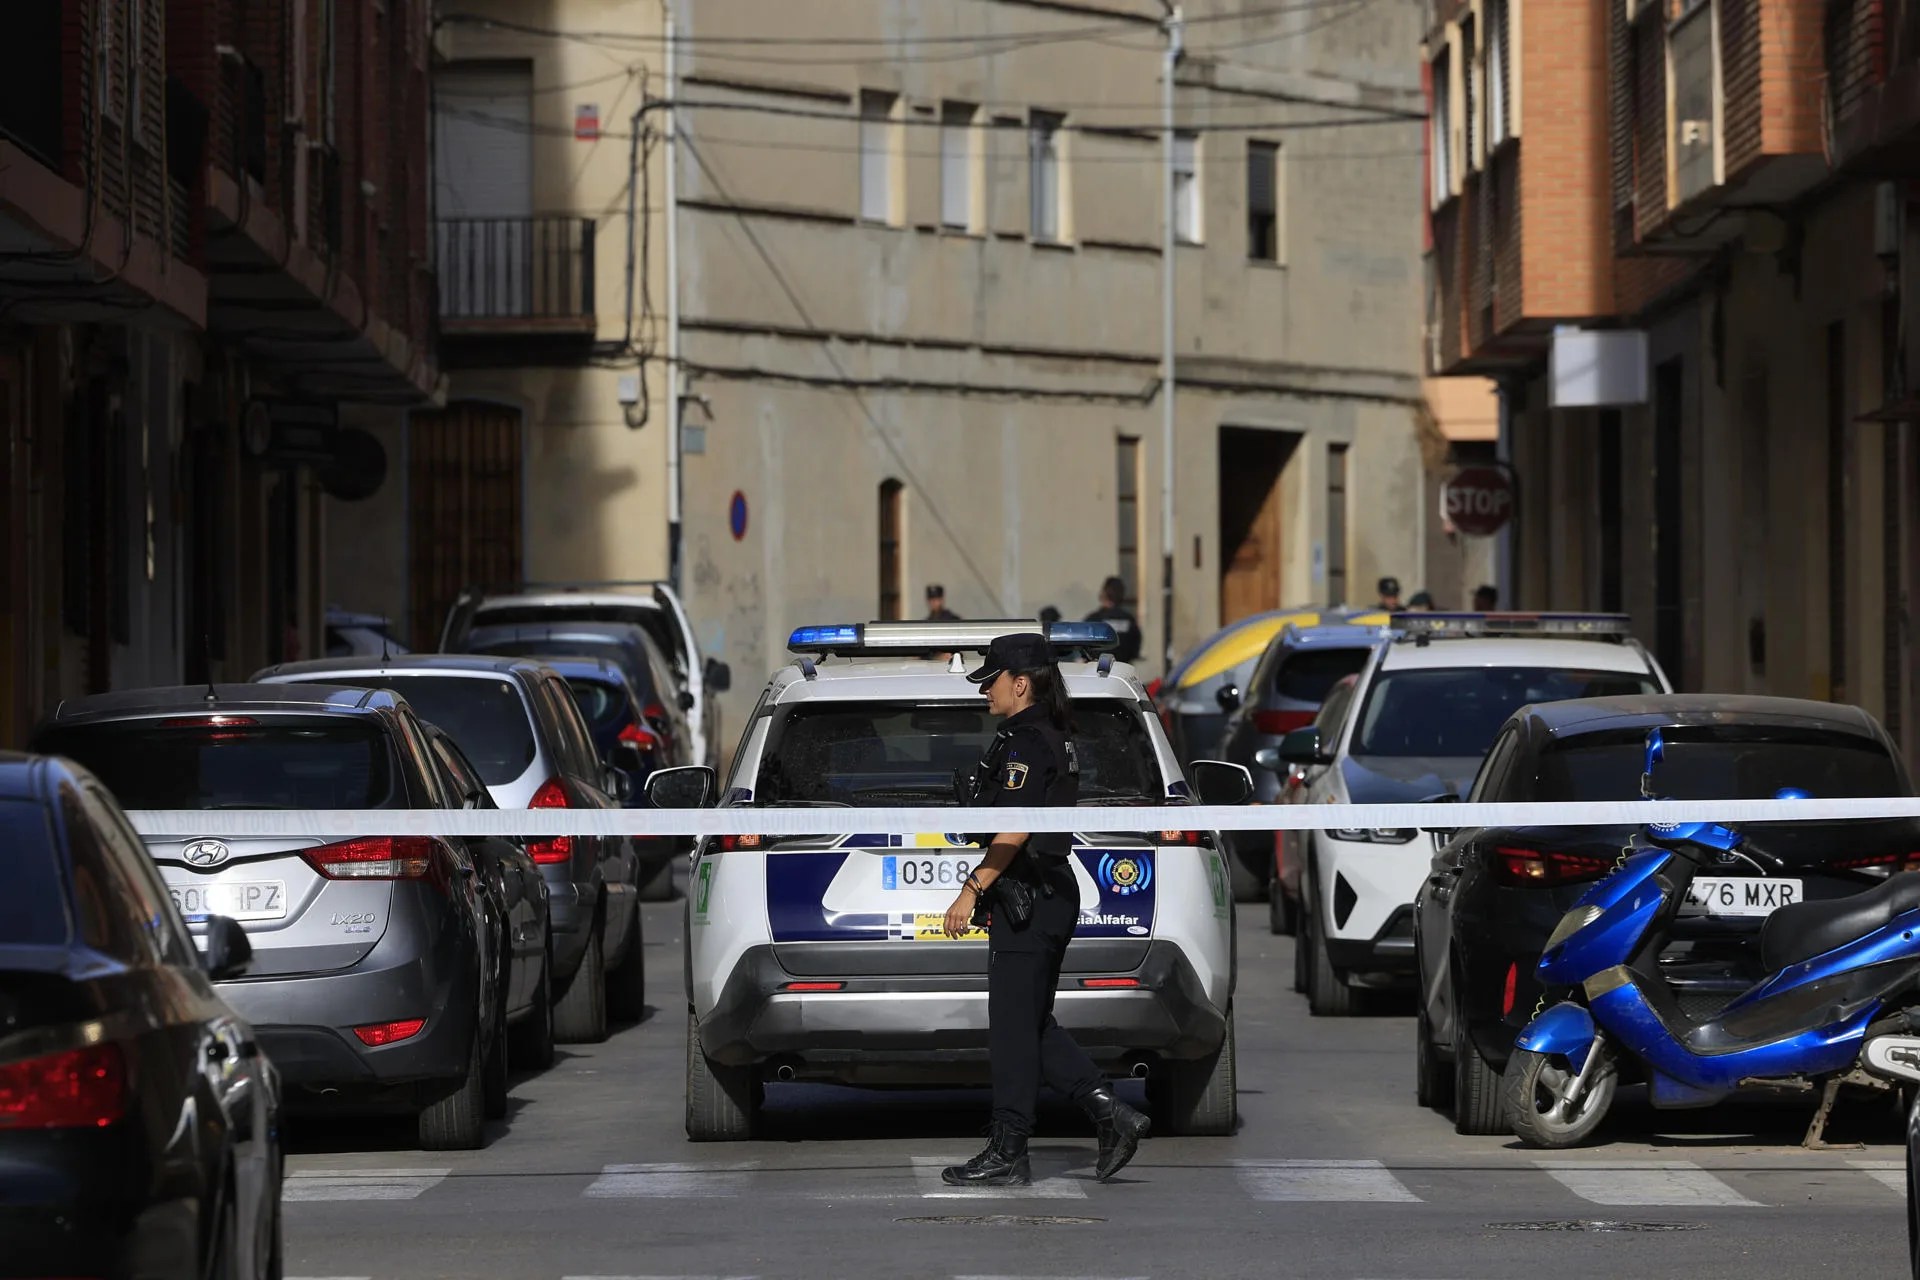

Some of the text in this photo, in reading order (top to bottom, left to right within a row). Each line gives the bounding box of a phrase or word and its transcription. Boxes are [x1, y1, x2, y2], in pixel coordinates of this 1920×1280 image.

[1447, 487, 1511, 515] STOP
[902, 860, 970, 885] 0368
[1745, 883, 1794, 906] MXR
